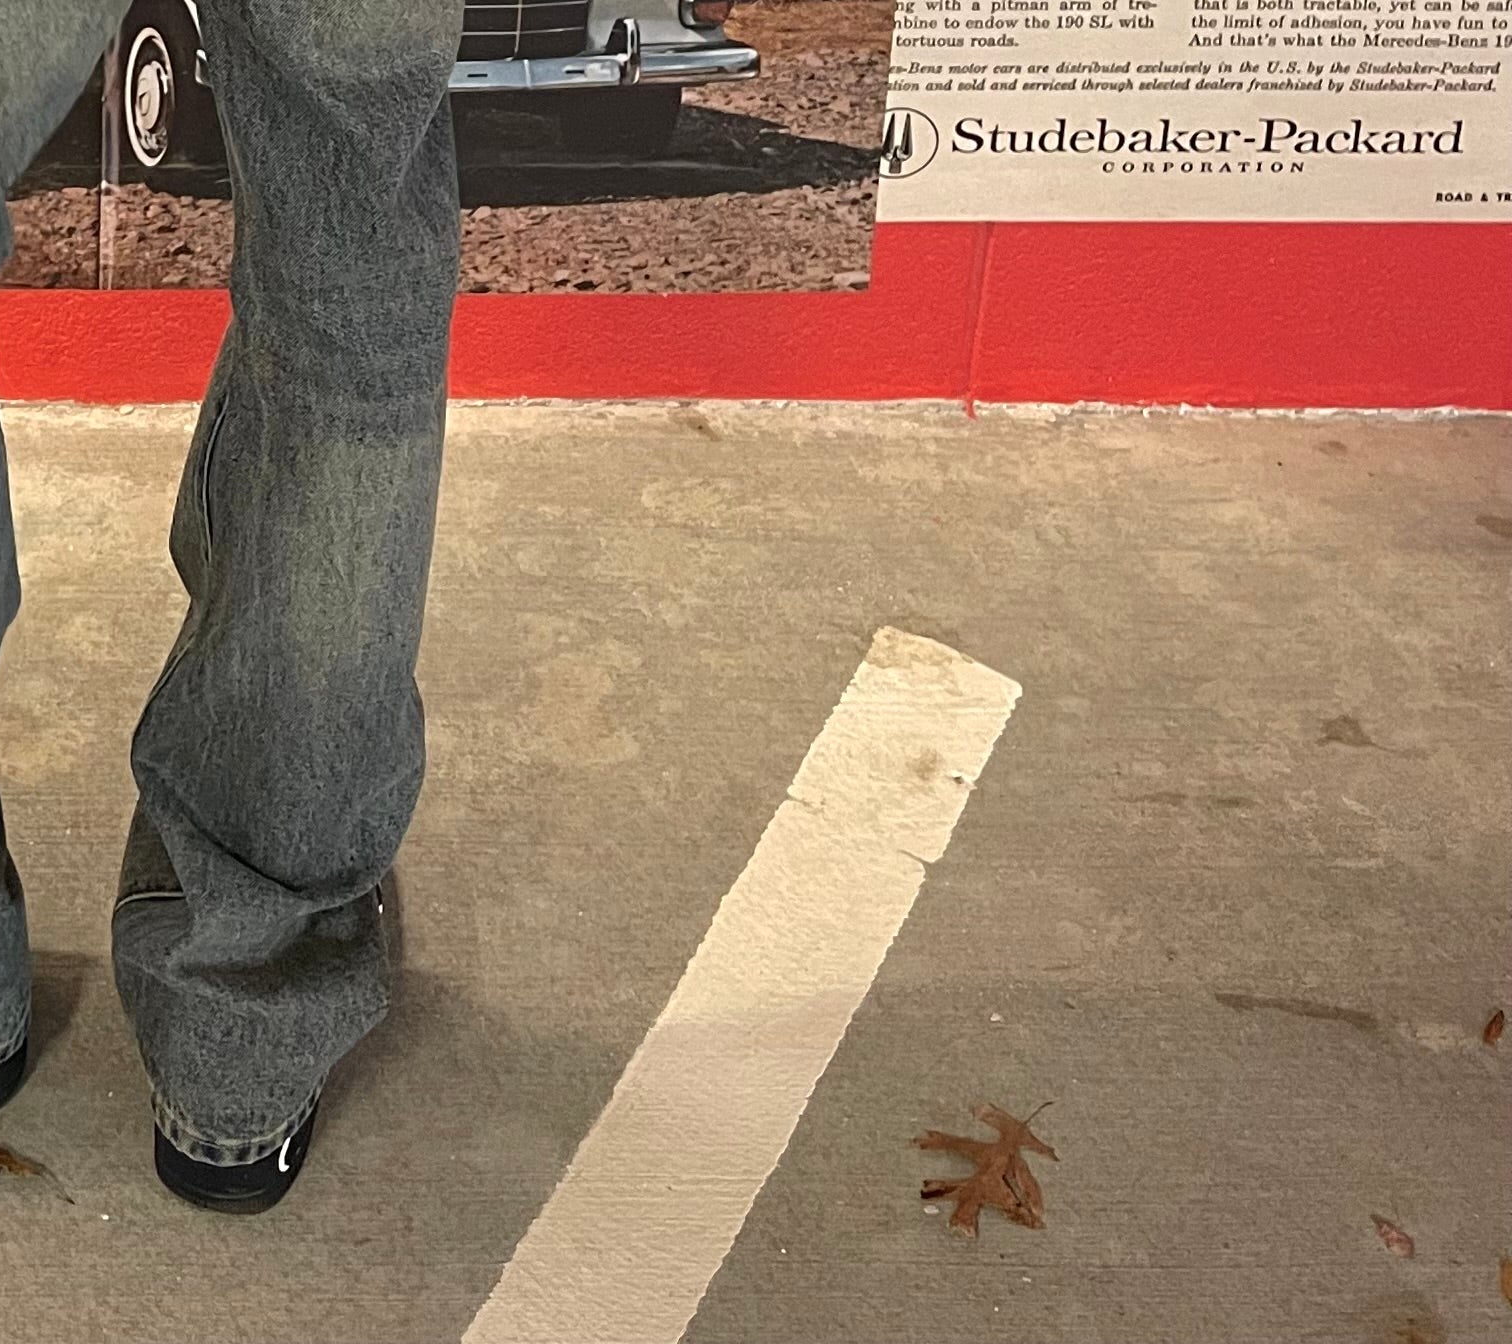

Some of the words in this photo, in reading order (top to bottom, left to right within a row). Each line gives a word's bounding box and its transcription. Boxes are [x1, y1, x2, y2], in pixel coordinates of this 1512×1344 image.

[896, 35, 964, 47] tortuous
[971, 34, 1019, 47] roads.
[950, 117, 1465, 156] Studebaker-Packard
[1101, 161, 1307, 175] CORPORATION
[1436, 192, 1473, 202] ROAD
